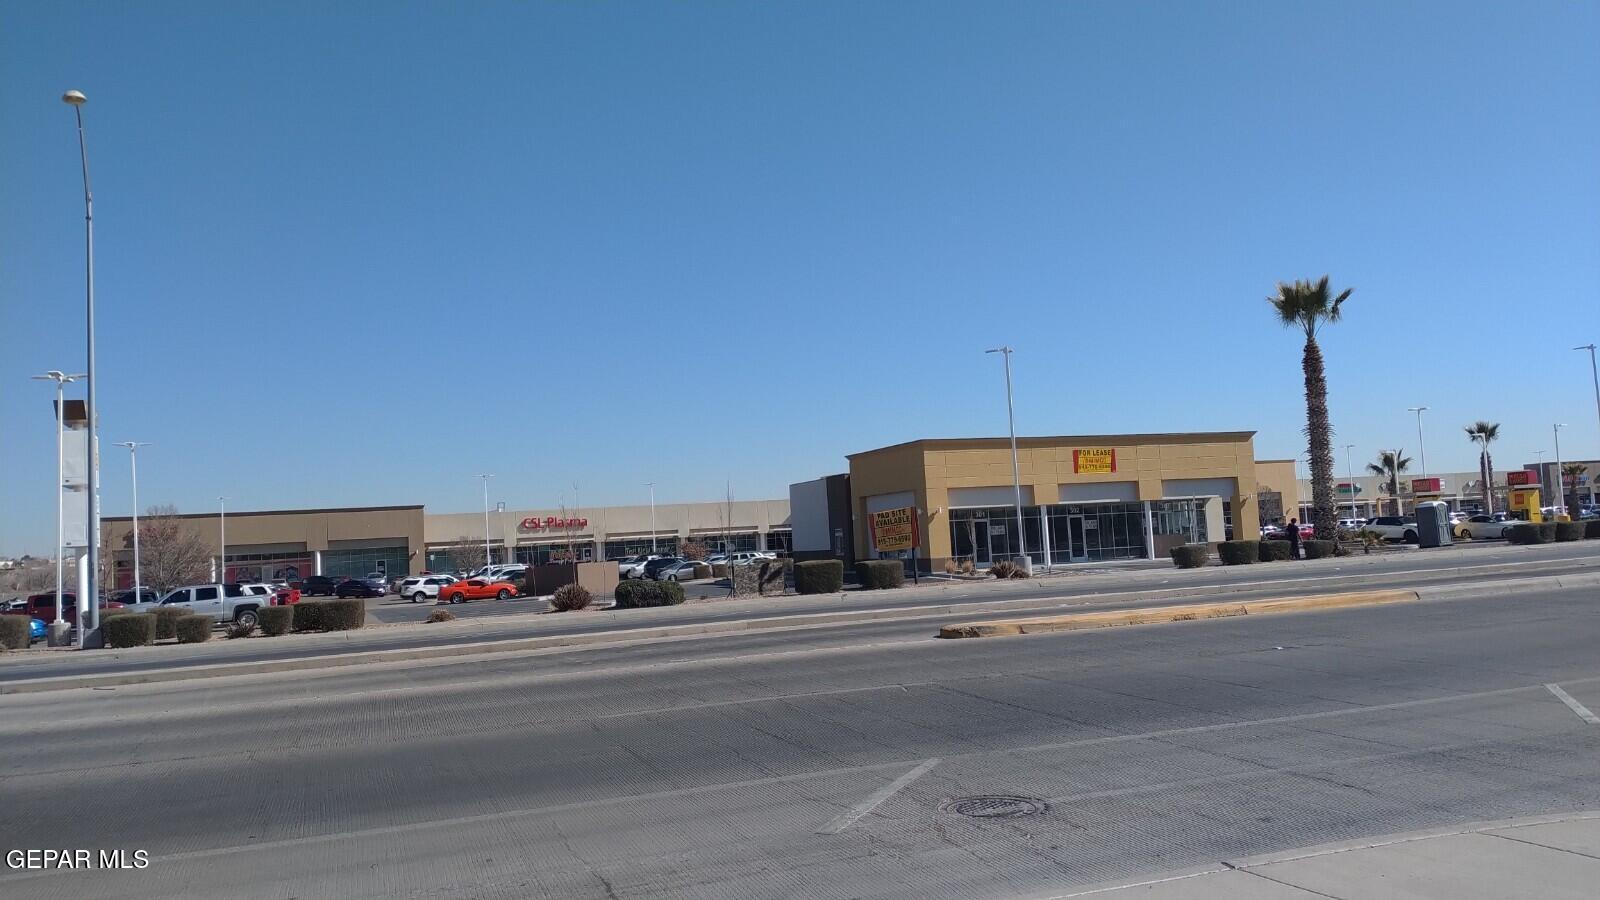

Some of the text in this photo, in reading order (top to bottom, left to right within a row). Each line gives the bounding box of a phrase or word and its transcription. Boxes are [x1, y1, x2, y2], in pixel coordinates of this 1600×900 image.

[1079, 449, 1111, 457] FOR LEASE
[891, 509, 906, 518] SITE
[523, 516, 588, 529] CSL Plasma
[876, 516, 910, 526] AVAILABLE
